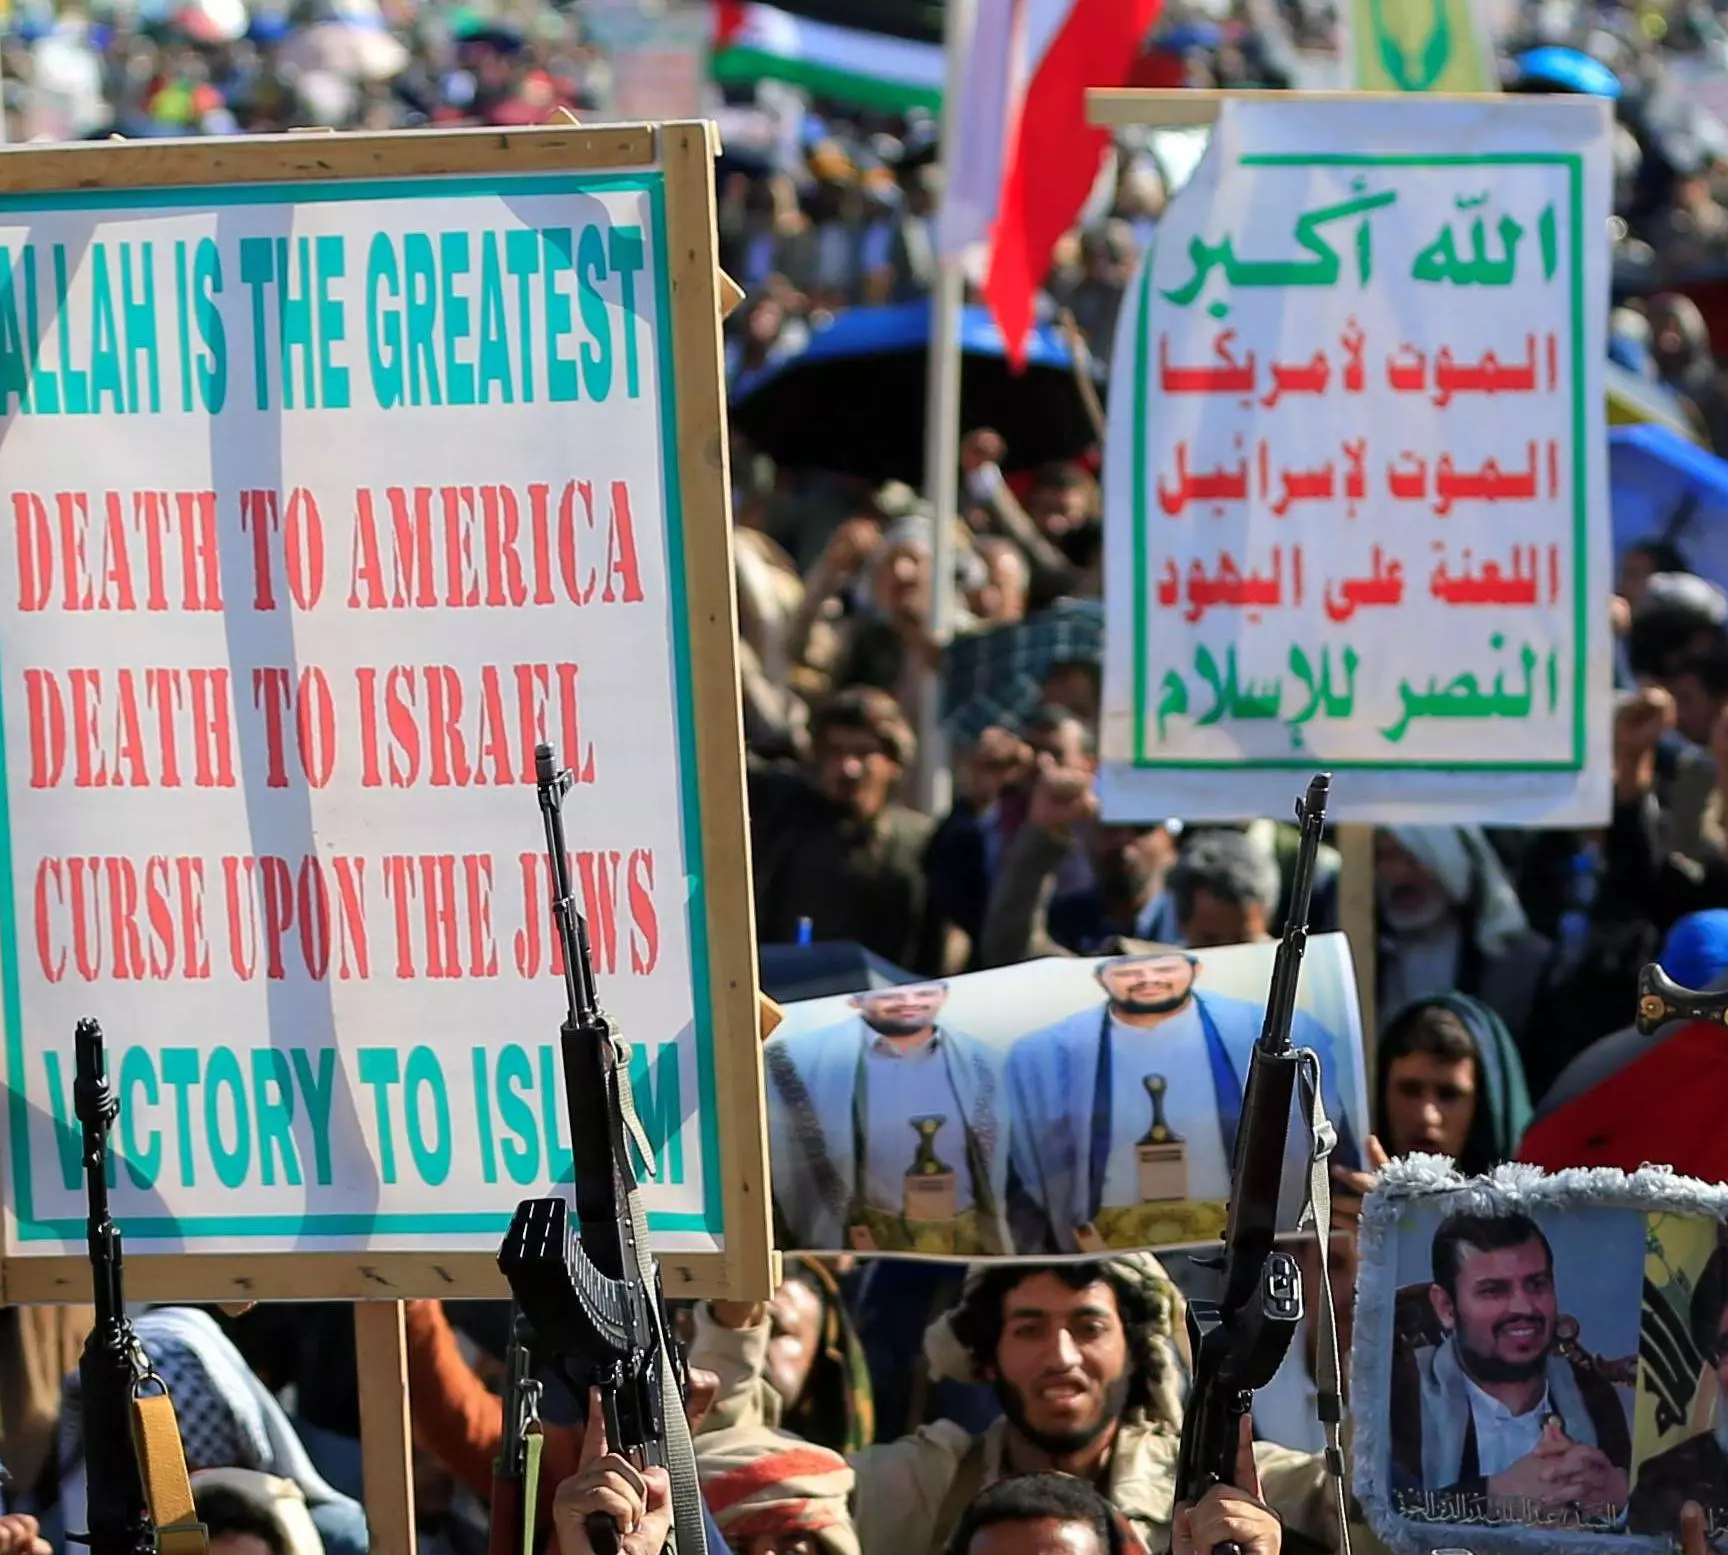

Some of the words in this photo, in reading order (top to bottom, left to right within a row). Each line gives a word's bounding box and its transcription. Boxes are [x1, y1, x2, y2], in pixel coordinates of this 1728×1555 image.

[1159, 175, 1397, 318] أكبر
[1412, 191, 1558, 287] الله
[174, 236, 228, 415] IS
[239, 235, 351, 411] THE
[366, 224, 645, 409] GREATEST
[1160, 318, 1365, 409] لأمريكا
[1388, 333, 1557, 409] الموت
[1159, 437, 1366, 517] لإسرائيل
[1388, 440, 1558, 517] الموت
[11, 490, 224, 612] DEATH
[241, 489, 325, 610] TO
[347, 480, 645, 610] AMERICA
[1158, 545, 1302, 623] اليهود
[1324, 545, 1405, 623] على
[1430, 545, 1558, 606] اللعنة
[24, 667, 237, 790] DEATH
[253, 667, 337, 789] TO
[356, 663, 596, 789] ISRAEL
[1158, 642, 1359, 747] للإسلام
[1383, 634, 1558, 742] النصر
[34, 855, 211, 982] CURSE
[221, 855, 369, 982] UPON
[382, 853, 499, 980] THE
[358, 1044, 453, 1187] TO
[471, 1043, 685, 1186] ISLM
